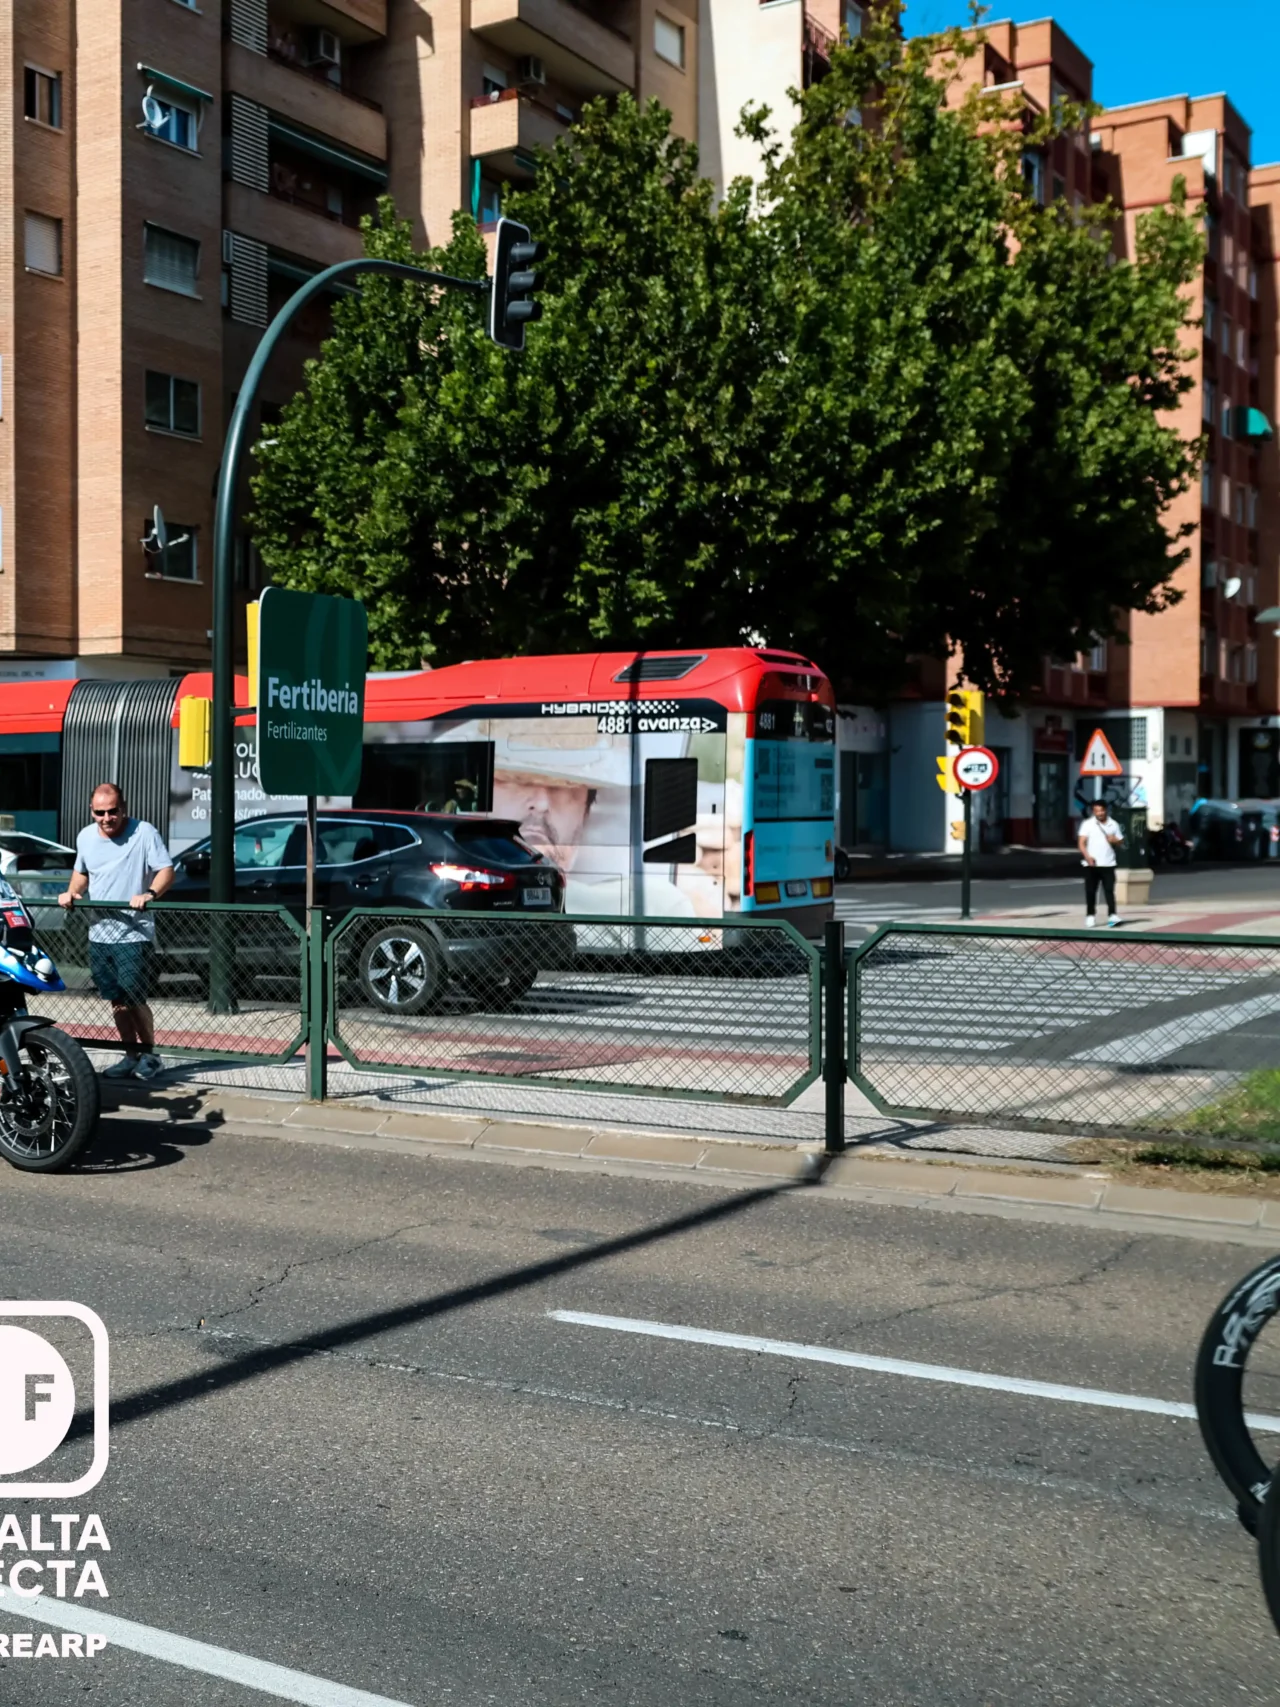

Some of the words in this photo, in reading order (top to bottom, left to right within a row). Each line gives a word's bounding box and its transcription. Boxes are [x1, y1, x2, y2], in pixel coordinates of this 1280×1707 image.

[268, 677, 359, 714] Fertiberia
[541, 702, 609, 714] HYBRID
[267, 721, 328, 741] Fertilizantes
[597, 717, 633, 733] 4881
[638, 717, 701, 731] avanza
